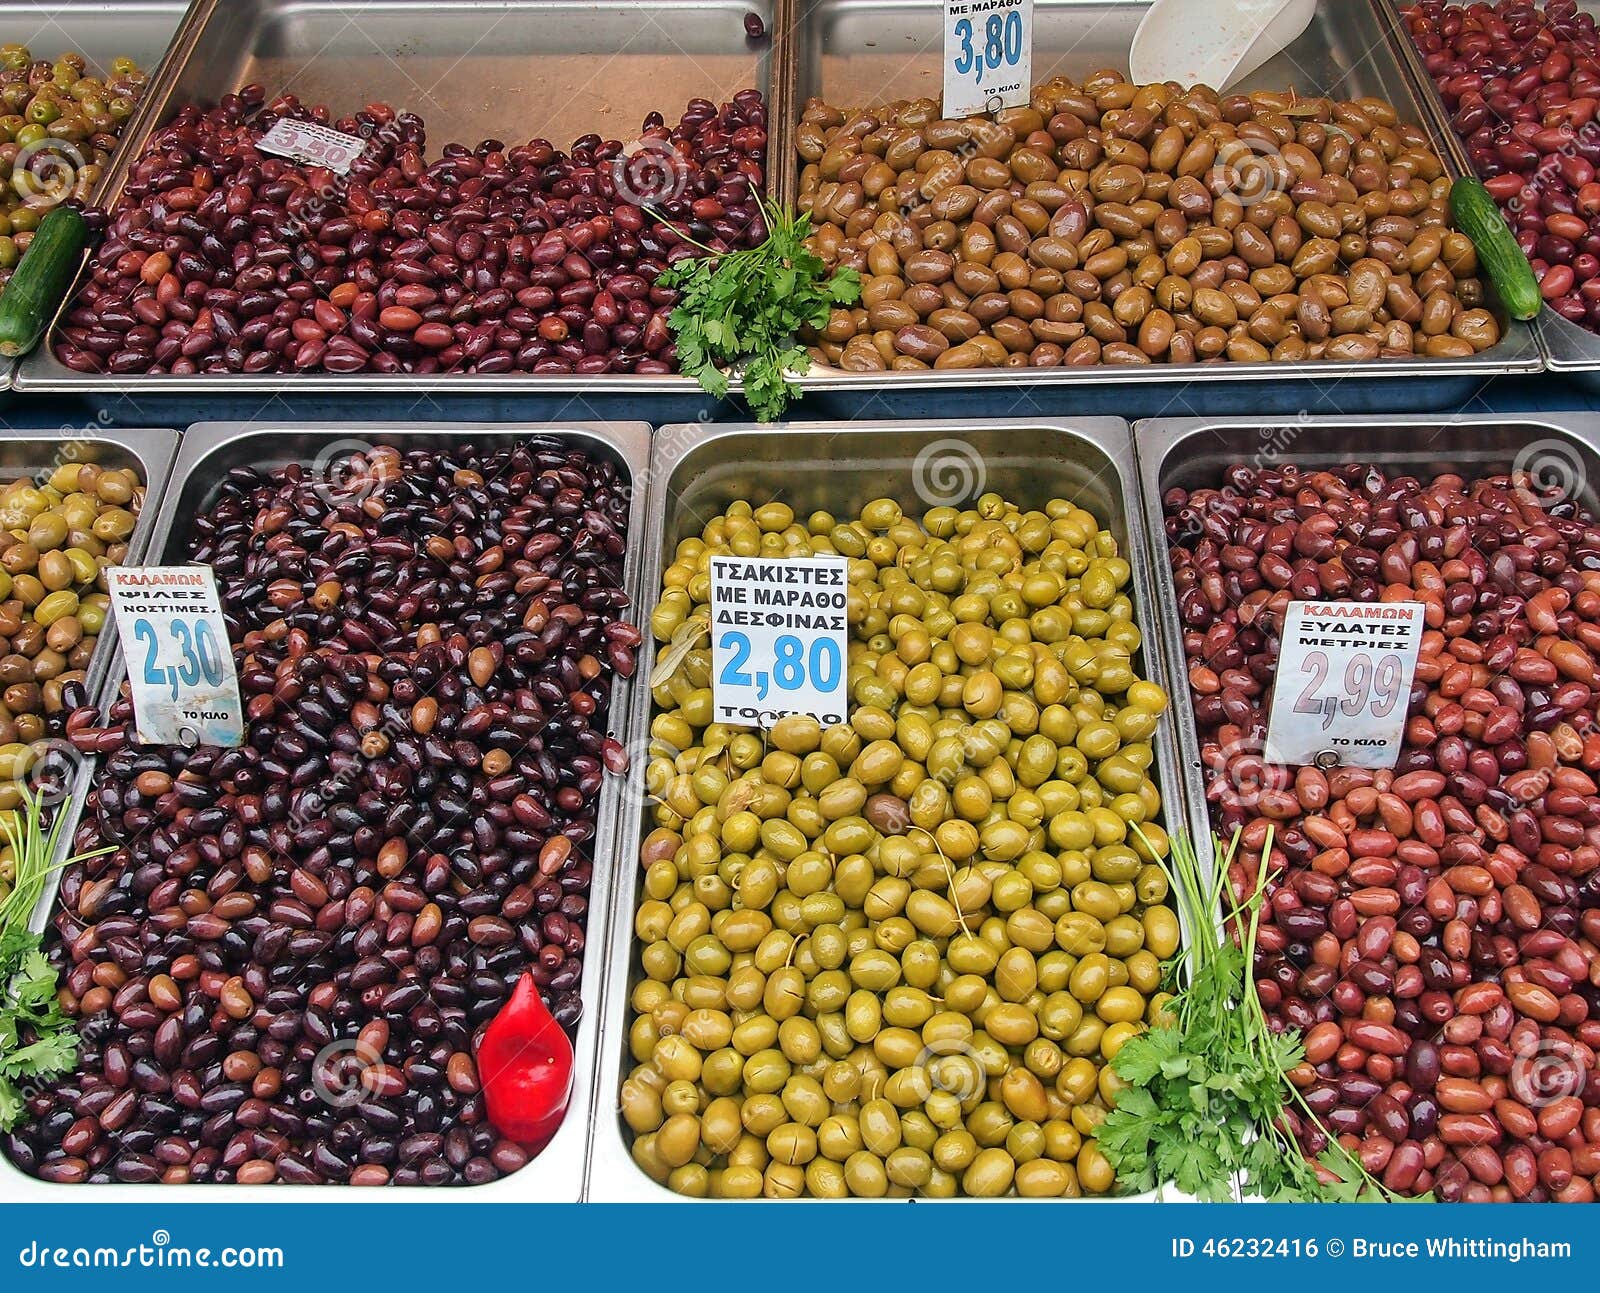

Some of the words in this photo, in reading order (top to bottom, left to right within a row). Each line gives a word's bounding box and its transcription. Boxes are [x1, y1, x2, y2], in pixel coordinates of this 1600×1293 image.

[949, 5, 968, 15] ΜΕ
[954, 10, 1023, 86] 3,80
[998, 83, 1020, 93] ΚΙΛΟ
[116, 574, 204, 586] ΚΑΛΑΜΩΝ
[713, 562, 844, 586] ΤΣΑΚΙΣΤΕΣ
[118, 591, 206, 599] ΨΙΛΕΣ
[716, 586, 747, 604] ΜΕ
[754, 588, 847, 609] ΜΑΡΑΘΟ
[717, 609, 845, 631] ΔΕΣΦΙΝΑΣ
[1303, 604, 1414, 620] ΚΑΛΑΜΩΝ
[1299, 620, 1411, 636] ΞΥΔΑΤΕΣ
[1299, 638, 1409, 650] ΜΕΤΡΙΕΣ
[134, 618, 224, 703] 2,30
[719, 630, 842, 702] 2,80
[1292, 650, 1403, 731] 2,99
[183, 711, 198, 719] ΤΟ
[201, 712, 229, 720] ΚΙΛΟ
[719, 706, 759, 718] ΤΟ
[1354, 738, 1387, 746] ΚΙΛΟ
